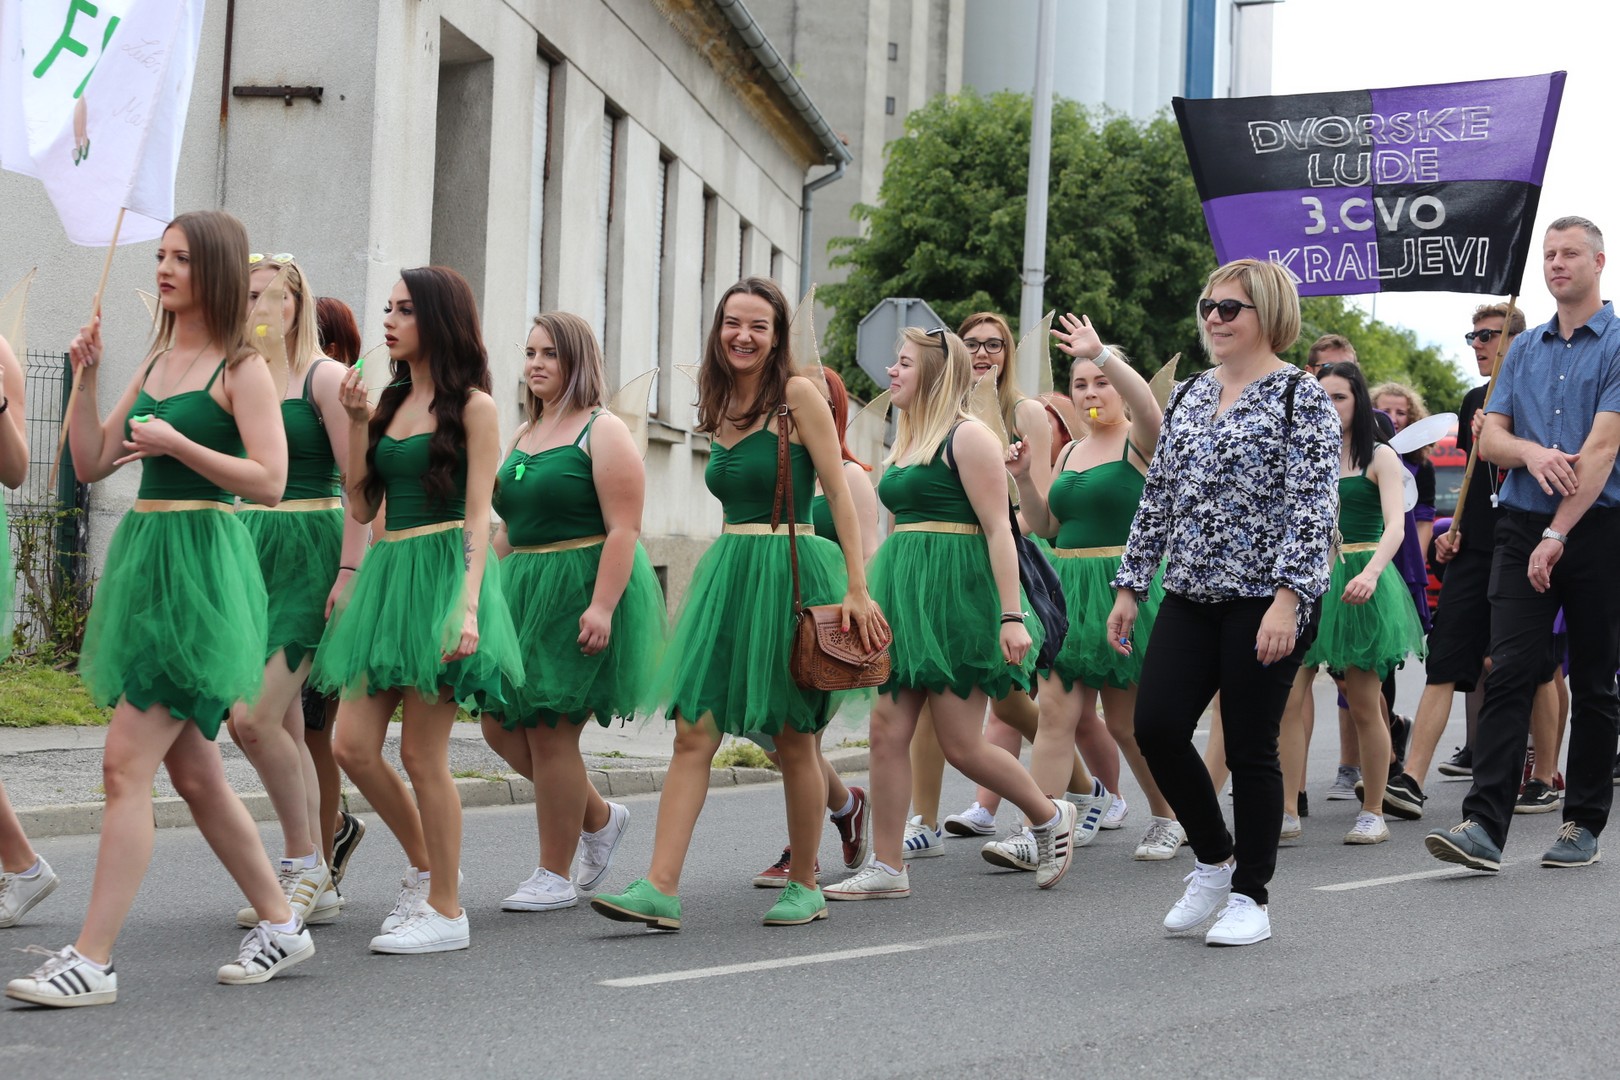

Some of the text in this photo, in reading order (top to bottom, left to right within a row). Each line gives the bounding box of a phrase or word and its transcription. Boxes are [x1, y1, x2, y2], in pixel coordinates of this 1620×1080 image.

[1249, 106, 1490, 154] DVORSKE
[1307, 147, 1439, 188] LUDE
[1301, 195, 1446, 235] 3.CVO
[1268, 236, 1490, 285] KRALJEVI
